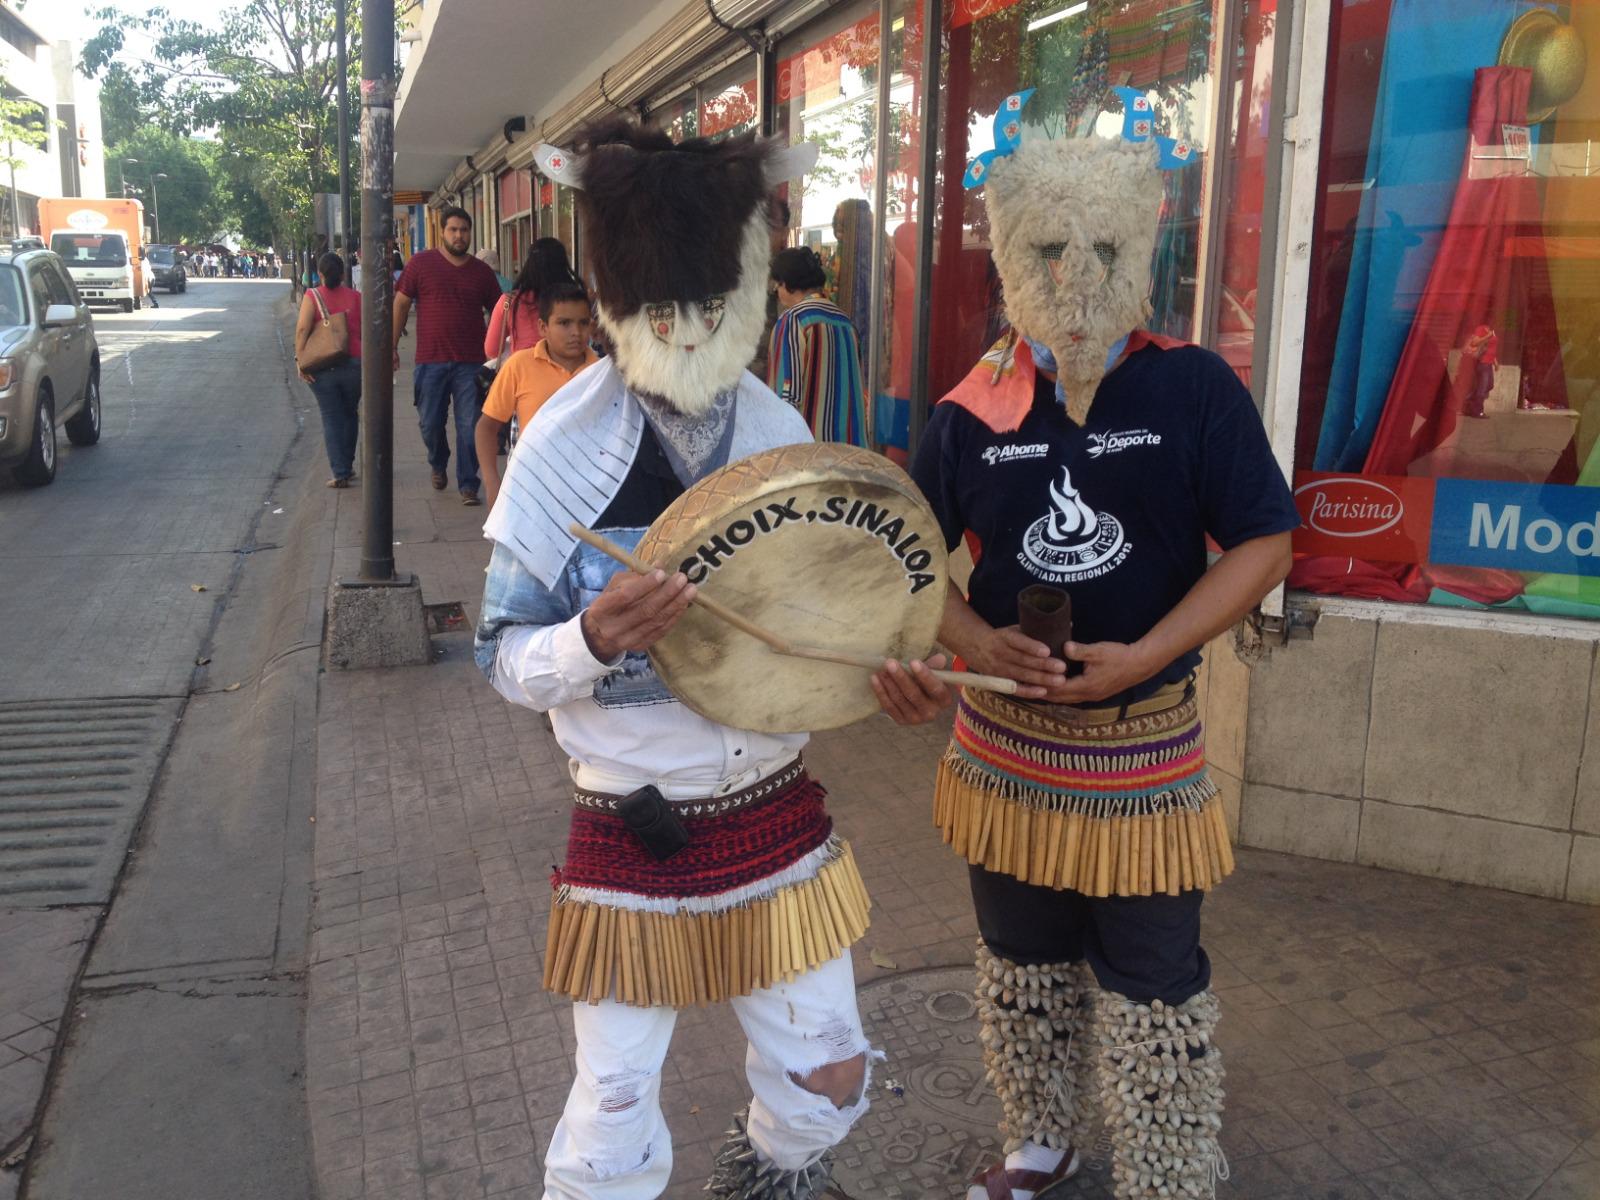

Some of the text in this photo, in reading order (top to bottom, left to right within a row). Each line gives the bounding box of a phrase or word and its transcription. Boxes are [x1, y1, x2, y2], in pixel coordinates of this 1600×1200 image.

[999, 443, 1049, 458] Ahome
[1107, 433, 1162, 449] Deporte
[1309, 491, 1395, 520] Parisina
[1468, 502, 1600, 557] Mod
[1016, 542, 1133, 583] OLIMPIADA REGIONAL 2013
